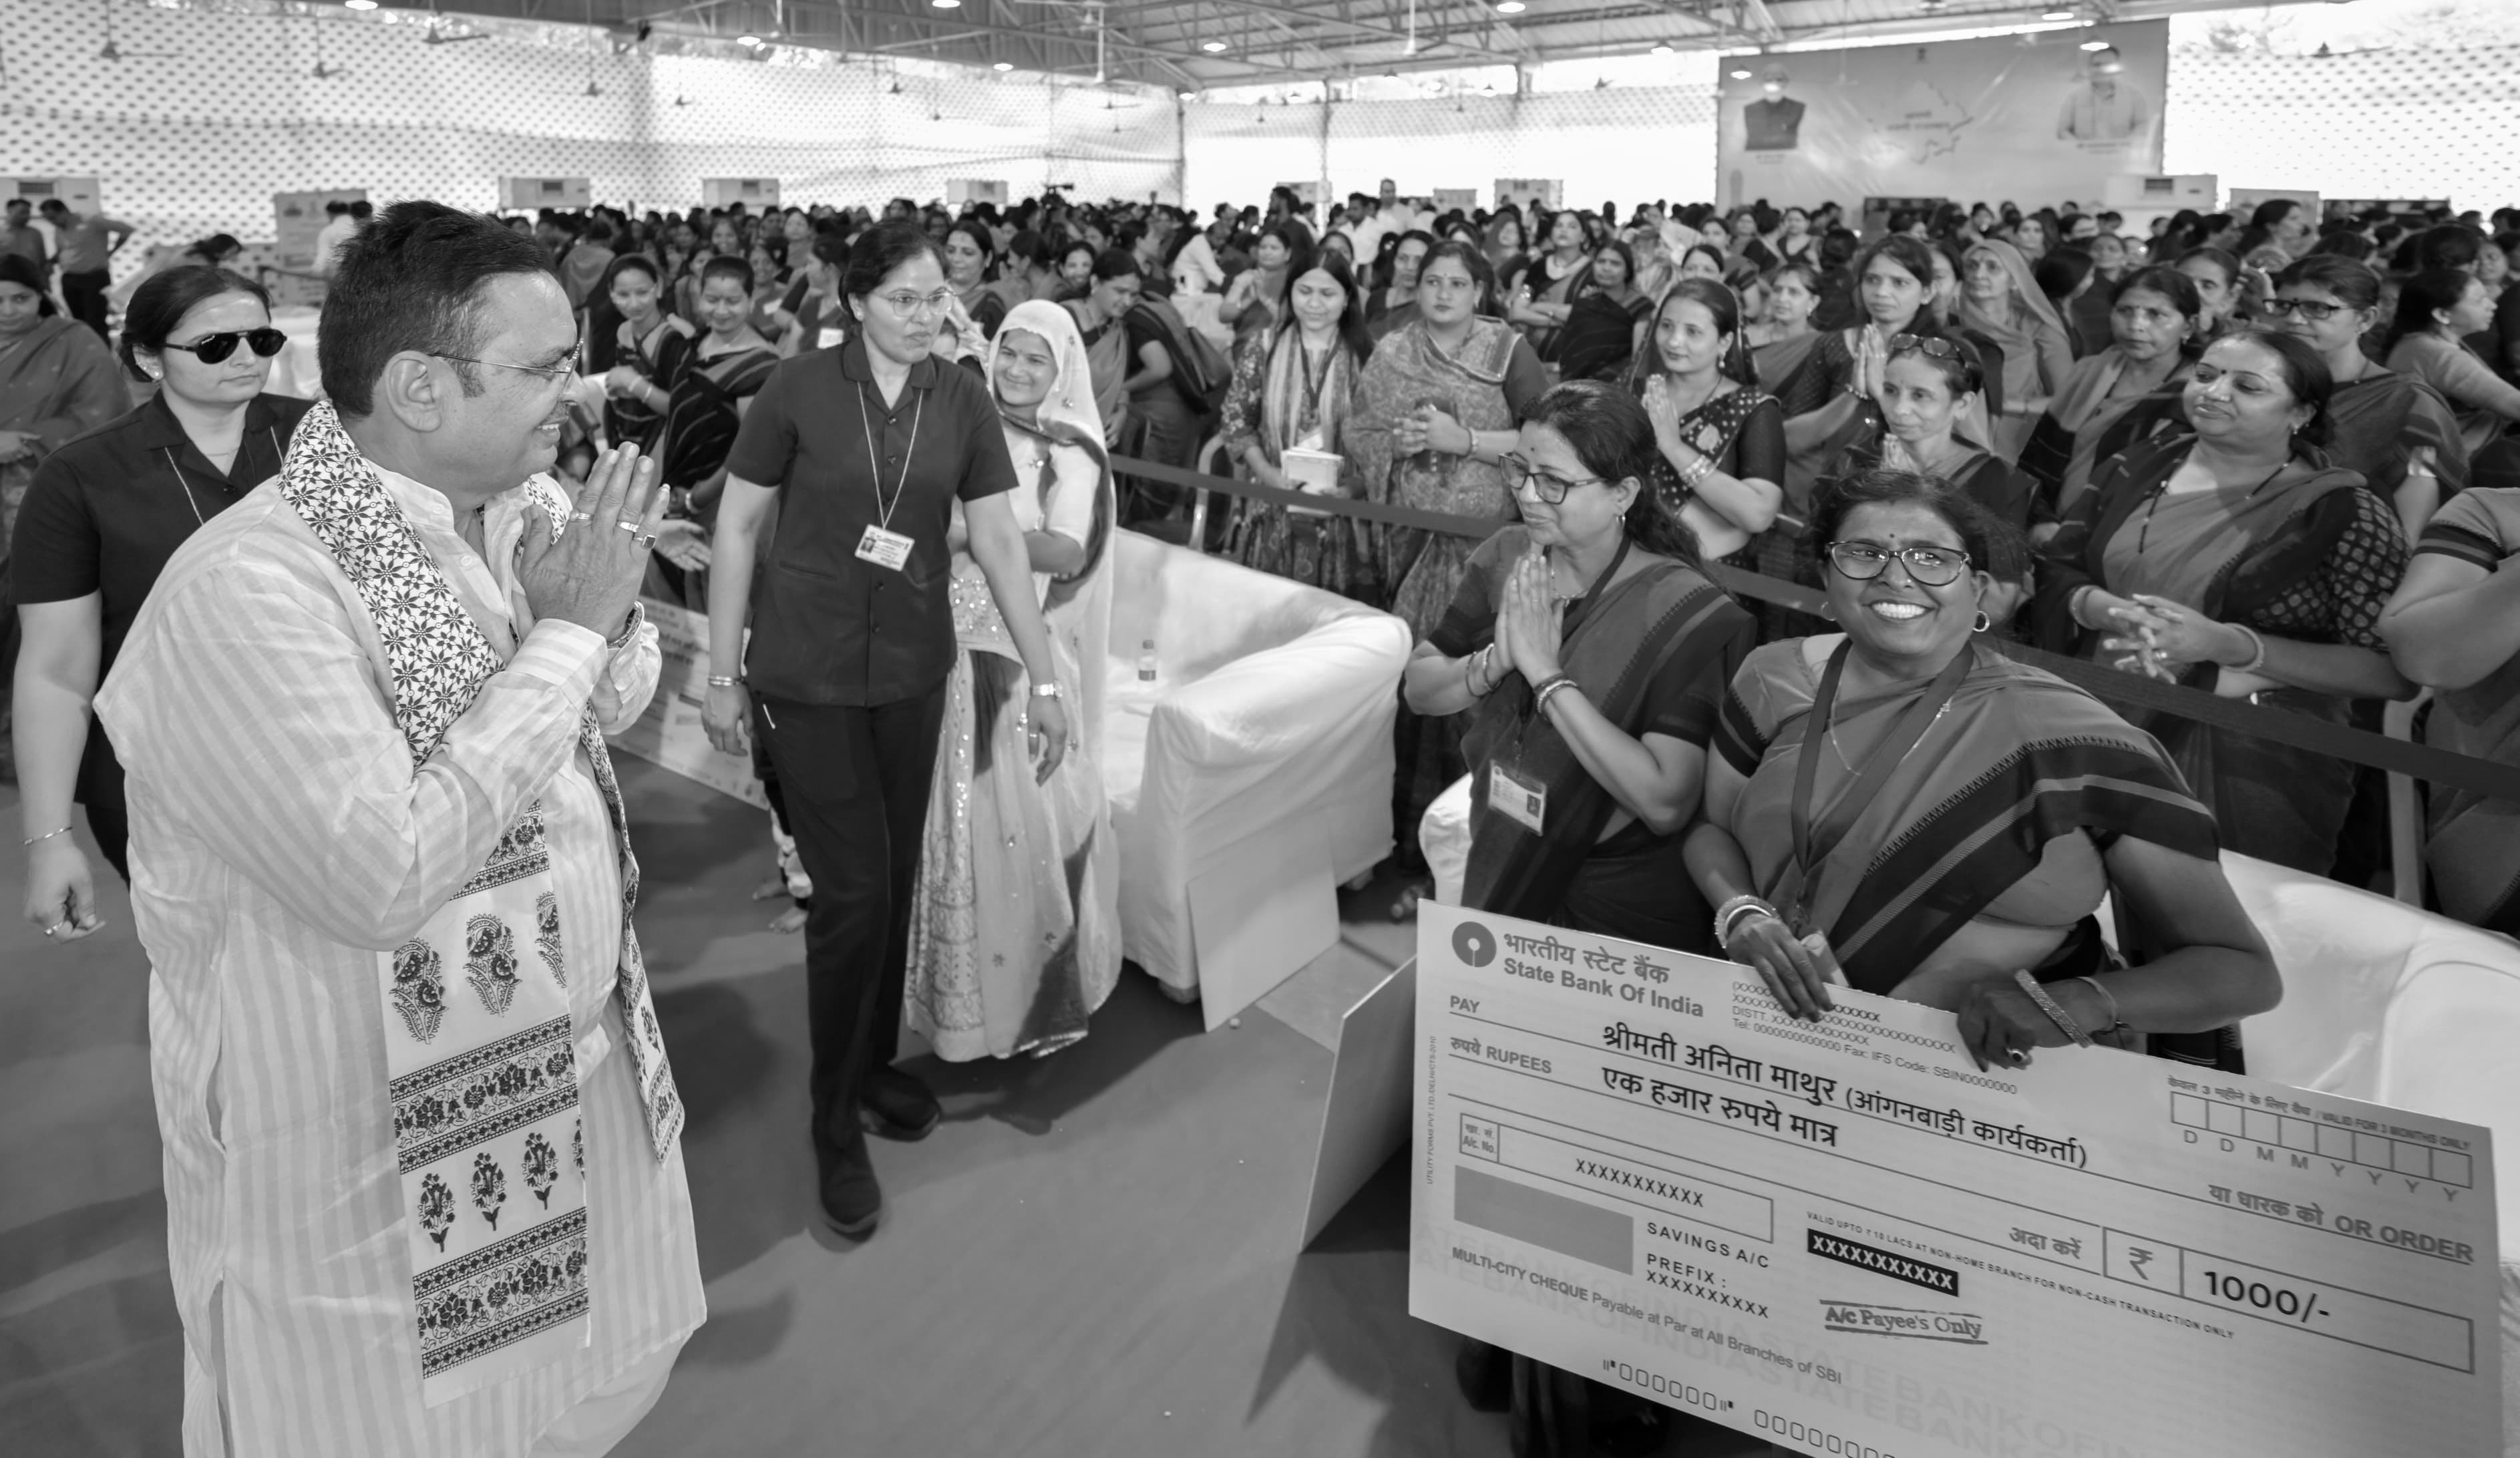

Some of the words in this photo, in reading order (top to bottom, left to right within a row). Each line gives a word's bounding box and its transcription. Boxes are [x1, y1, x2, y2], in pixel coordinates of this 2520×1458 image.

[1504, 934, 1576, 964] भारतीय
[1583, 946, 1626, 974] स्टेट
[1634, 955, 1670, 984] बैंक
[1450, 995, 1480, 1013] PAY
[1504, 958, 1554, 983] State
[1561, 970, 1613, 996] Bank
[1620, 984, 1645, 1003] Of
[1651, 989, 1704, 1017] India
[1450, 1037, 1481, 1055] रुपये
[1486, 1046, 1552, 1073] RUPEES
[1871, 1051, 1892, 1065] IFS
[1896, 1057, 1930, 1074] Code:
[1603, 1022, 1677, 1062] श्रीमती
[1684, 1044, 1763, 1083] अनिता
[1769, 1065, 1838, 1106] माथुर
[1972, 1120, 2087, 1169] कार्यकर्ता)
[1603, 1067, 1642, 1096] एक
[1652, 1077, 1713, 1114] हजार
[1720, 1097, 1783, 1133] रुपये
[1790, 1115, 1838, 1147] मात्र
[2201, 1086, 2211, 1095] 3
[1576, 1158, 1703, 1208] XXXXXXXXXXX
[2183, 1129, 2198, 1144] D
[2219, 1137, 2235, 1153] D
[2257, 1146, 2274, 1163] M
[2291, 1153, 2308, 1170] M
[2330, 1161, 2346, 1177] Y
[2366, 1170, 2383, 1186] Y
[2404, 1179, 2420, 1194] Y
[2443, 1187, 2459, 1202] Y
[1647, 1222, 1731, 1258] SAVINGS
[1737, 1249, 1769, 1269] A/C
[2009, 1226, 2046, 1249] अदा
[2052, 1238, 2082, 1260] करें
[2208, 1183, 2231, 1204] या
[2237, 1190, 2290, 1217] धारक
[2296, 1202, 2324, 1226] को
[2335, 1215, 2372, 1239] OR
[2380, 1225, 2475, 1262] ORDER
[1647, 1253, 1715, 1284] PREFIX
[1807, 1211, 1835, 1226] VALID
[1837, 1220, 1863, 1234] UPTO
[1886, 1234, 1914, 1248] LACS
[1915, 1242, 1928, 1252] AT
[1930, 1248, 1985, 1270] NON-HOME
[1987, 1263, 2032, 1283] BRANCH
[2034, 1277, 2056, 1290] FOR
[2119, 1300, 2200, 1330] TRANSACTION
[2203, 1322, 2234, 1339] ONLY
[1812, 1235, 1953, 1290] XXXXXXXXXXX
[1452, 1246, 1526, 1281] MULTI-CITY
[1529, 1268, 1588, 1302] CHEQUE
[1592, 1291, 1644, 1321] Payable
[1648, 1312, 1661, 1326] at
[1664, 1315, 1688, 1333] Par
[1690, 1324, 1704, 1339] at
[1706, 1330, 1724, 1344] All
[1728, 1336, 1795, 1369] Branches
[1797, 1360, 1813, 1375] of
[1815, 1366, 1841, 1385] SBI
[1646, 1270, 1769, 1318] XXXXXXXXXX
[2204, 1270, 2330, 1324] 1000/-
[1825, 1306, 1857, 1324] A/c
[1860, 1308, 1930, 1332] Payee's
[1934, 1316, 1982, 1340] Only
